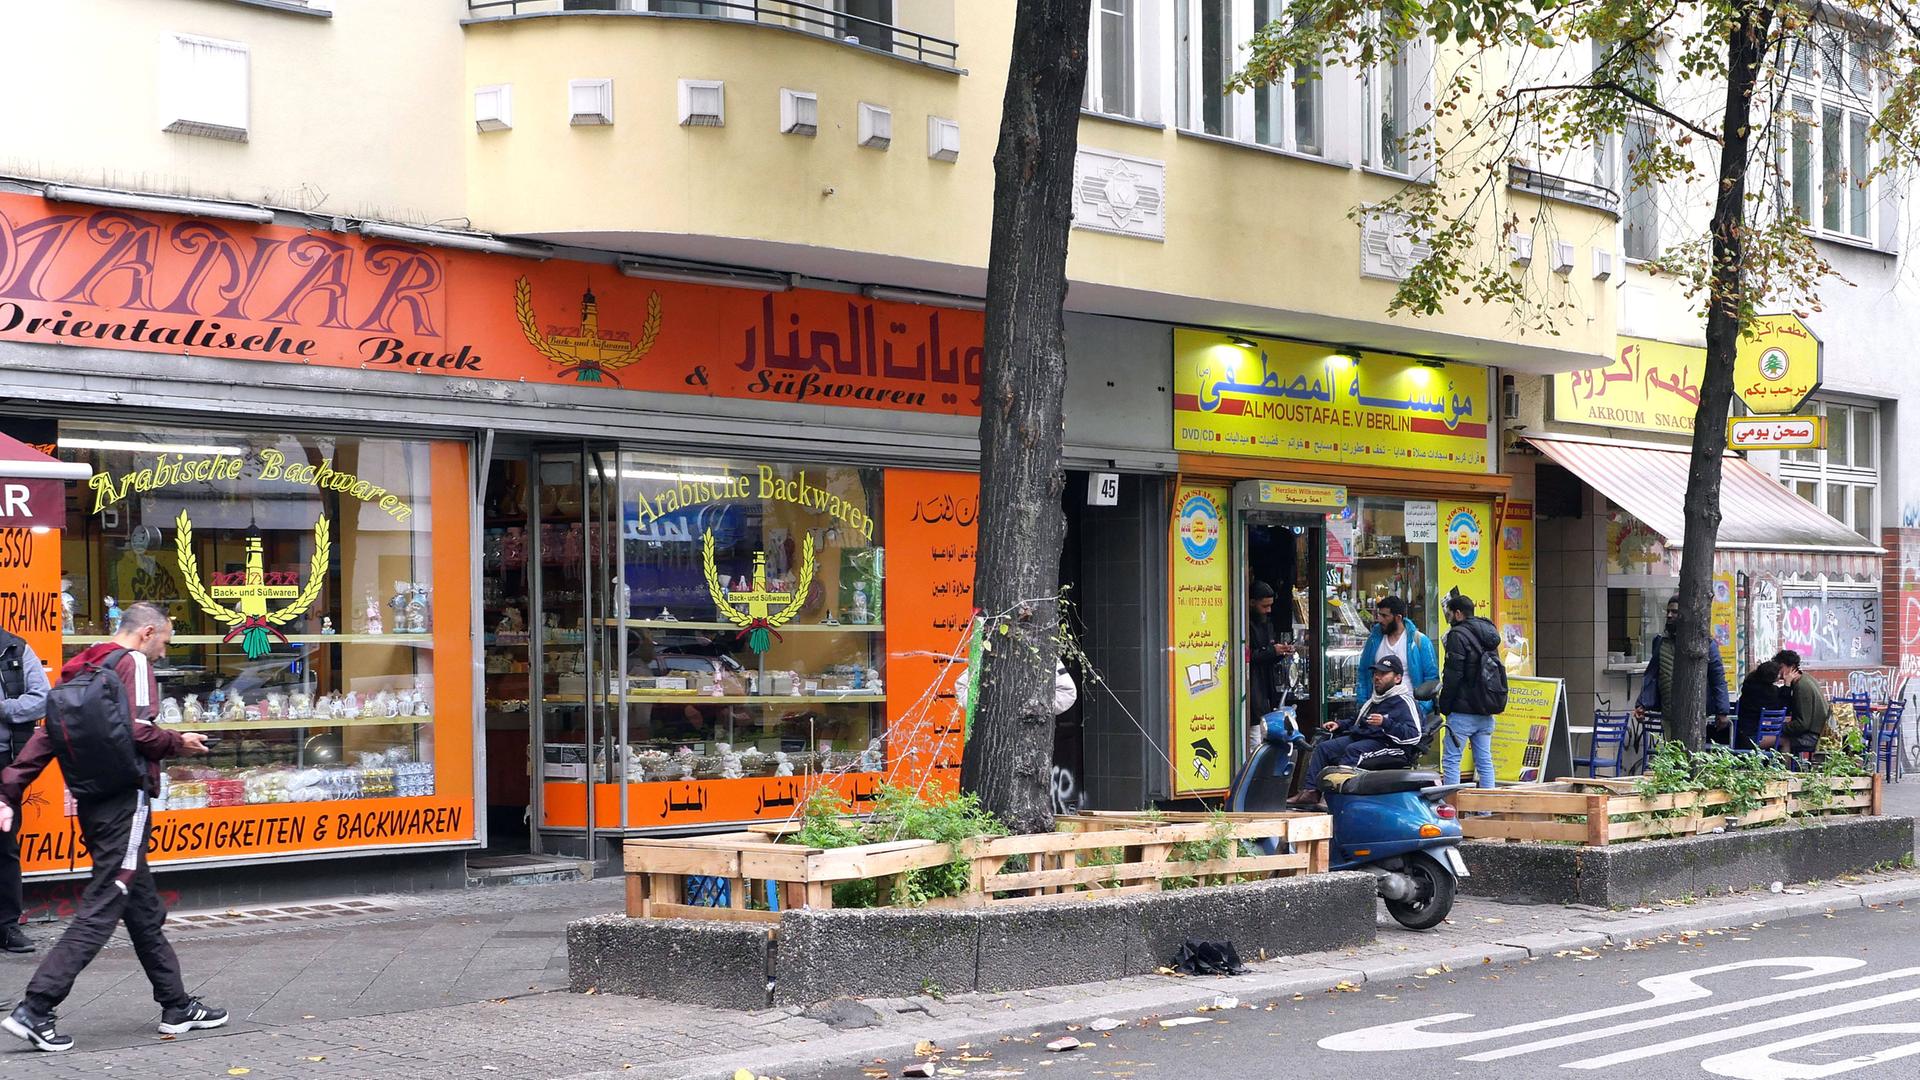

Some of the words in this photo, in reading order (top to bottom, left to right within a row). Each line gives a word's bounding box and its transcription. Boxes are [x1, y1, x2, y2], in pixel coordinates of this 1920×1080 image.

[358, 336, 485, 372] Back
[685, 364, 709, 386] &
[748, 368, 926, 406] Süßwaren
[1646, 364, 1701, 407] طعم
[1243, 401, 1340, 427] ALMOUSTAFA
[1366, 412, 1412, 433] BERLIN
[1588, 406, 1646, 424] AKROUM
[1736, 425, 1769, 443] يومي
[1773, 423, 1809, 440] صحن
[89, 452, 242, 516] Arabische
[258, 449, 413, 523] Backwaren
[1101, 479, 1116, 498] 45
[636, 464, 749, 530] Arabische
[758, 465, 875, 541] Backwaren
[213, 588, 237, 597] Back-
[240, 588, 254, 597] und
[257, 588, 297, 597] Süßwaren
[748, 594, 759, 602] und
[150, 814, 305, 853] SÜSSIGKEITEN
[314, 814, 328, 836] &
[337, 806, 462, 840] BACKWAREN
